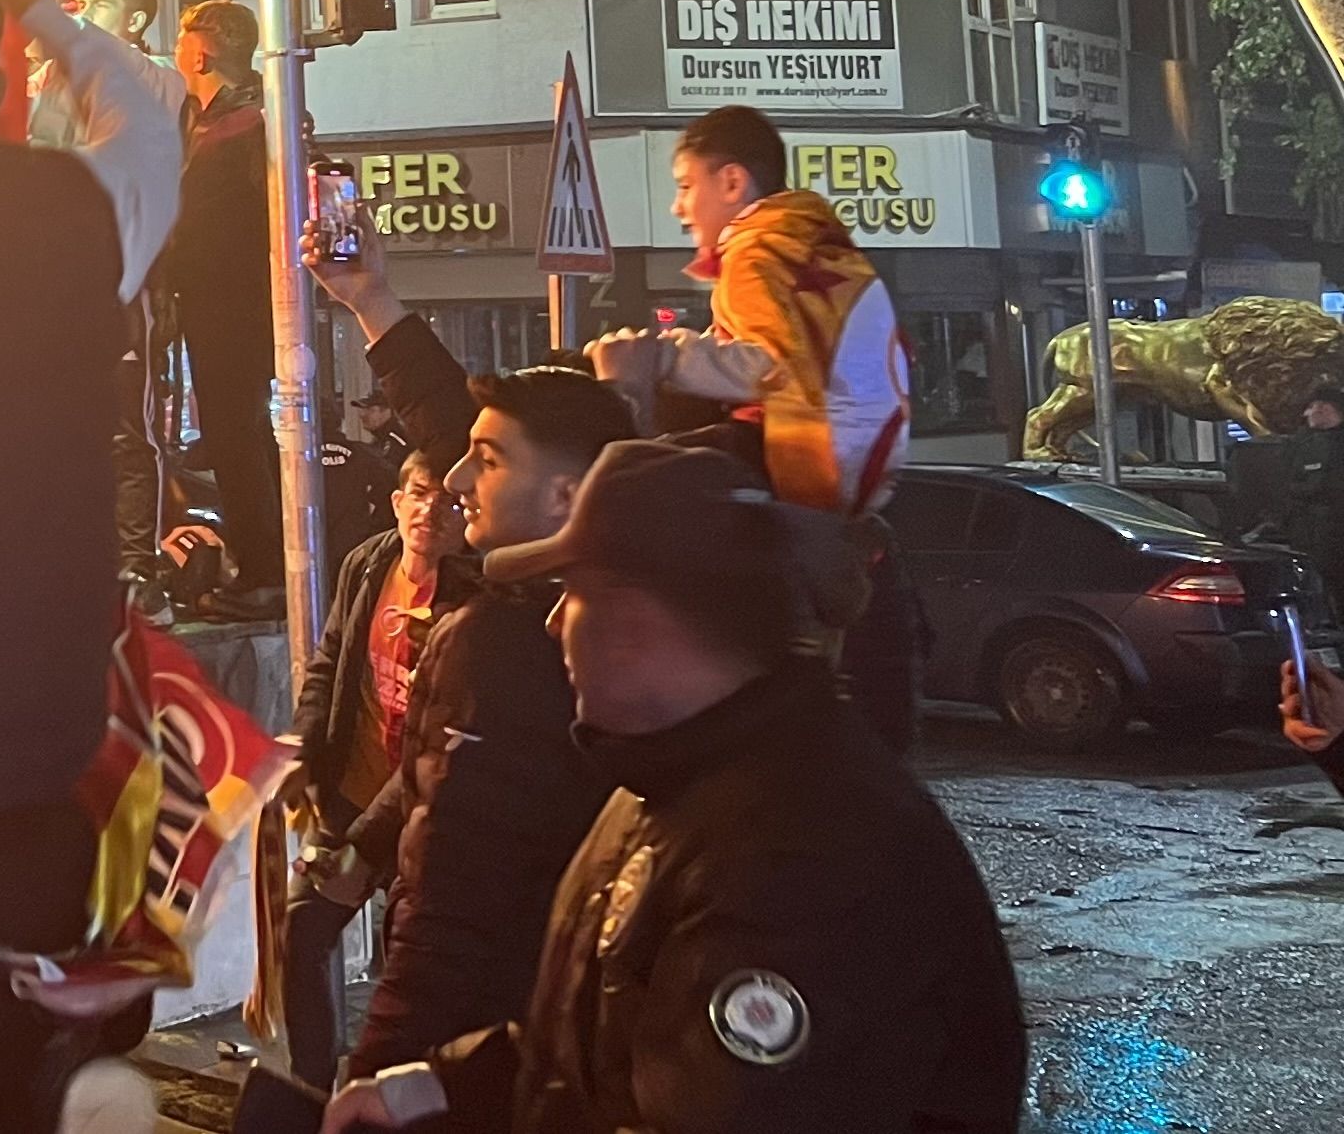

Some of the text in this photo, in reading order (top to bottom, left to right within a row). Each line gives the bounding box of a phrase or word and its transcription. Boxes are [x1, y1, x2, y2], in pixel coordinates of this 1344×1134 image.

[682, 54, 762, 81] Dursun
[360, 153, 466, 200] FER
[787, 145, 904, 191] FER
